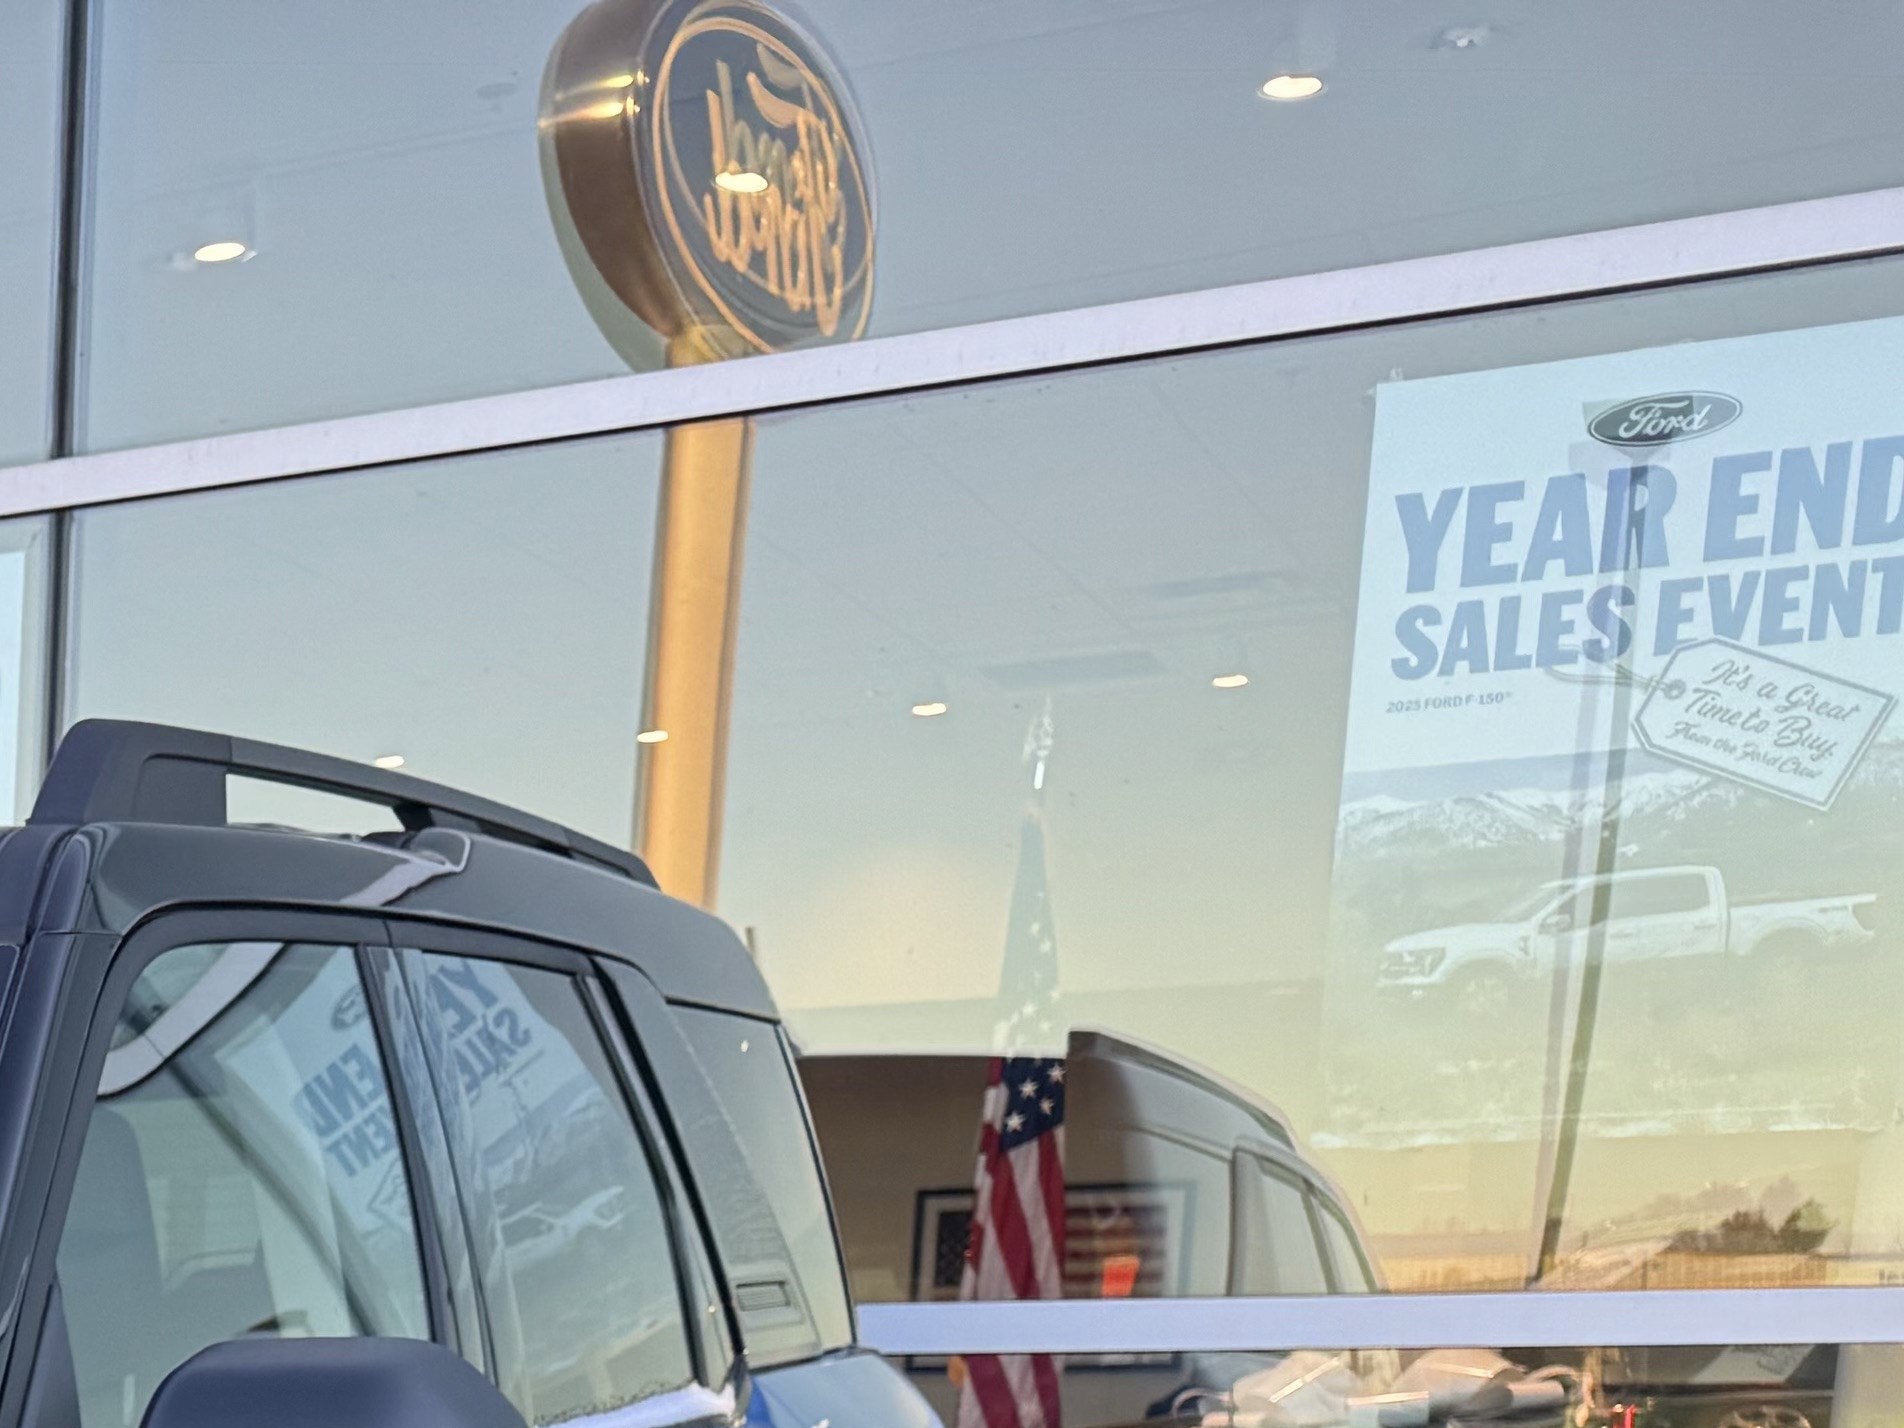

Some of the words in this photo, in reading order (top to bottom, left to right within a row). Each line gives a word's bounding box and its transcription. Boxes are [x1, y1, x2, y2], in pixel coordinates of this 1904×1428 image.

[1619, 401, 1713, 440] Ford
[1395, 465, 1678, 594] YEAR
[1703, 435, 1904, 562] END
[1391, 585, 1635, 680] SALES
[1654, 557, 1904, 656] EVENT
[1386, 701, 1422, 713] 2025
[1424, 695, 1463, 711] FORD
[1685, 687, 1742, 725] Time
[1741, 707, 1770, 733] to
[1703, 660, 1753, 691] It's
[1757, 682, 1778, 699] a
[1775, 683, 1860, 720] Great
